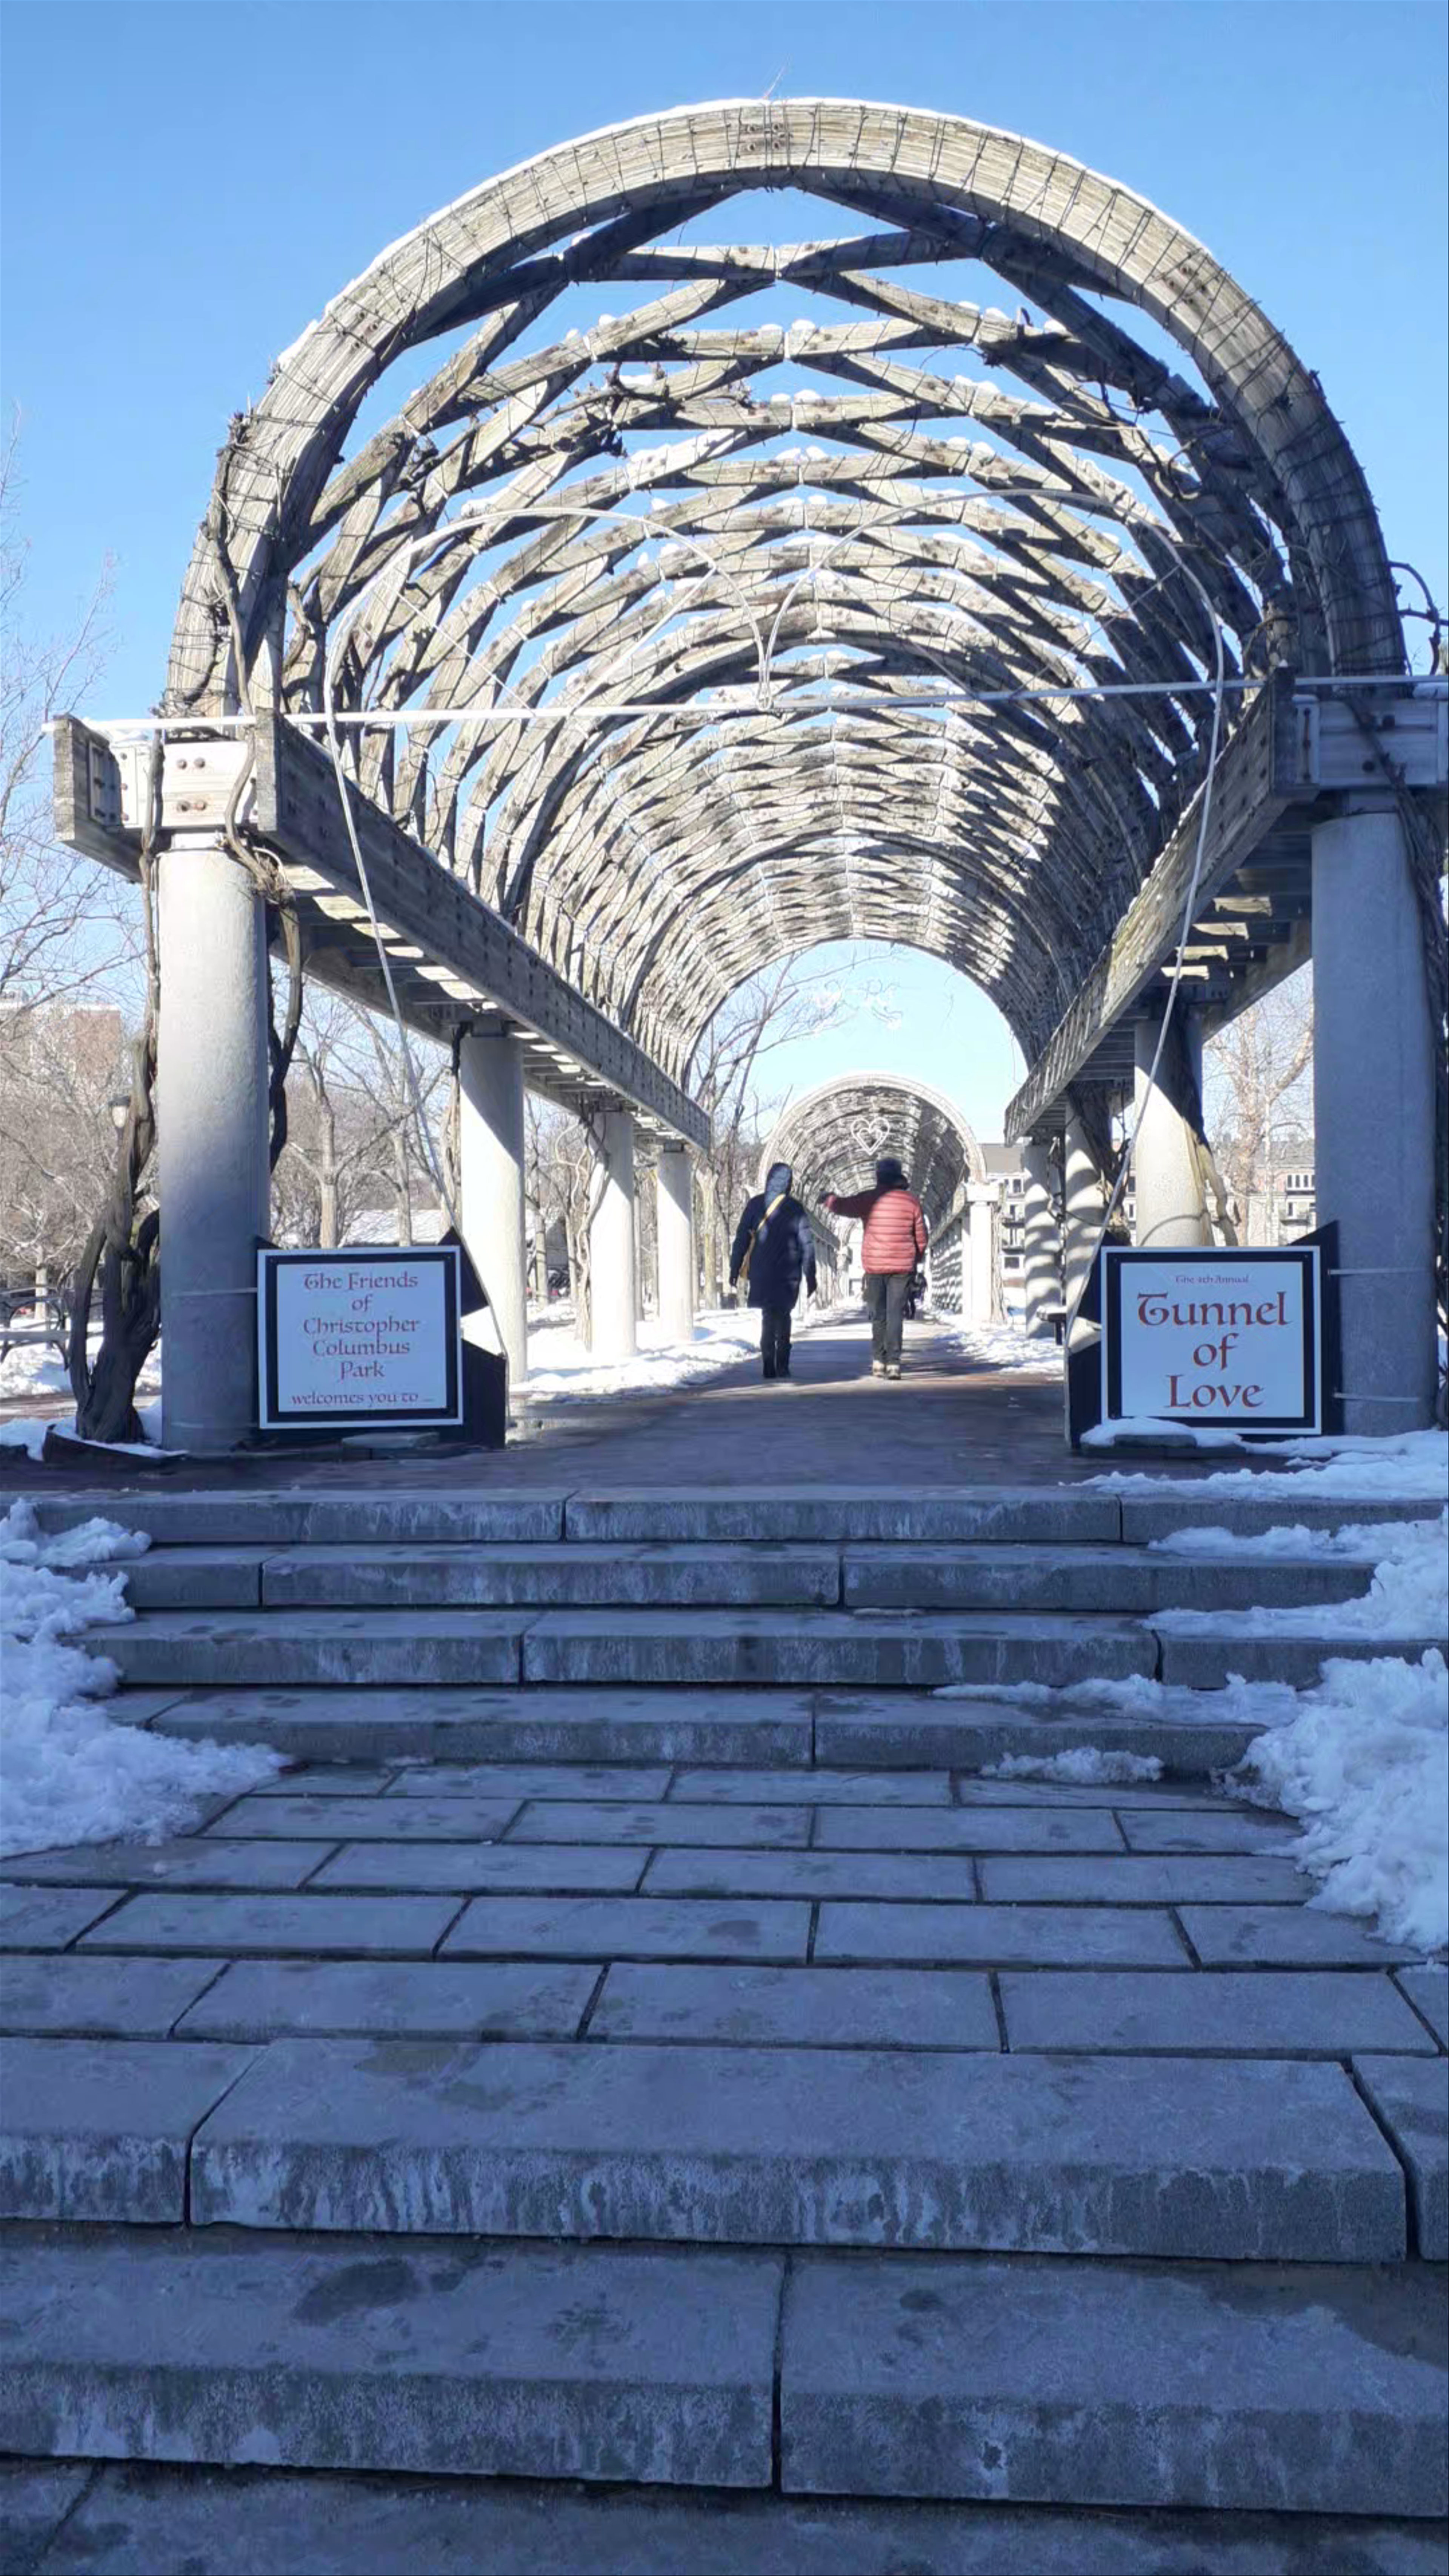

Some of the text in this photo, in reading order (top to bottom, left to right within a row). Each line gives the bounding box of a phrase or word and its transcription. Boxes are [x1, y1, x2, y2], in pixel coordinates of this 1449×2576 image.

[304, 1271, 418, 1290] The Friends
[351, 1293, 374, 1312] of
[1137, 1291, 1291, 1326] Tunnel
[303, 1316, 420, 1339] Christopher
[313, 1338, 411, 1356] Columbus
[1193, 1332, 1240, 1370] of
[340, 1360, 385, 1381] Park
[291, 1391, 420, 1407] welcomes you to
[1166, 1374, 1264, 1408] Love
